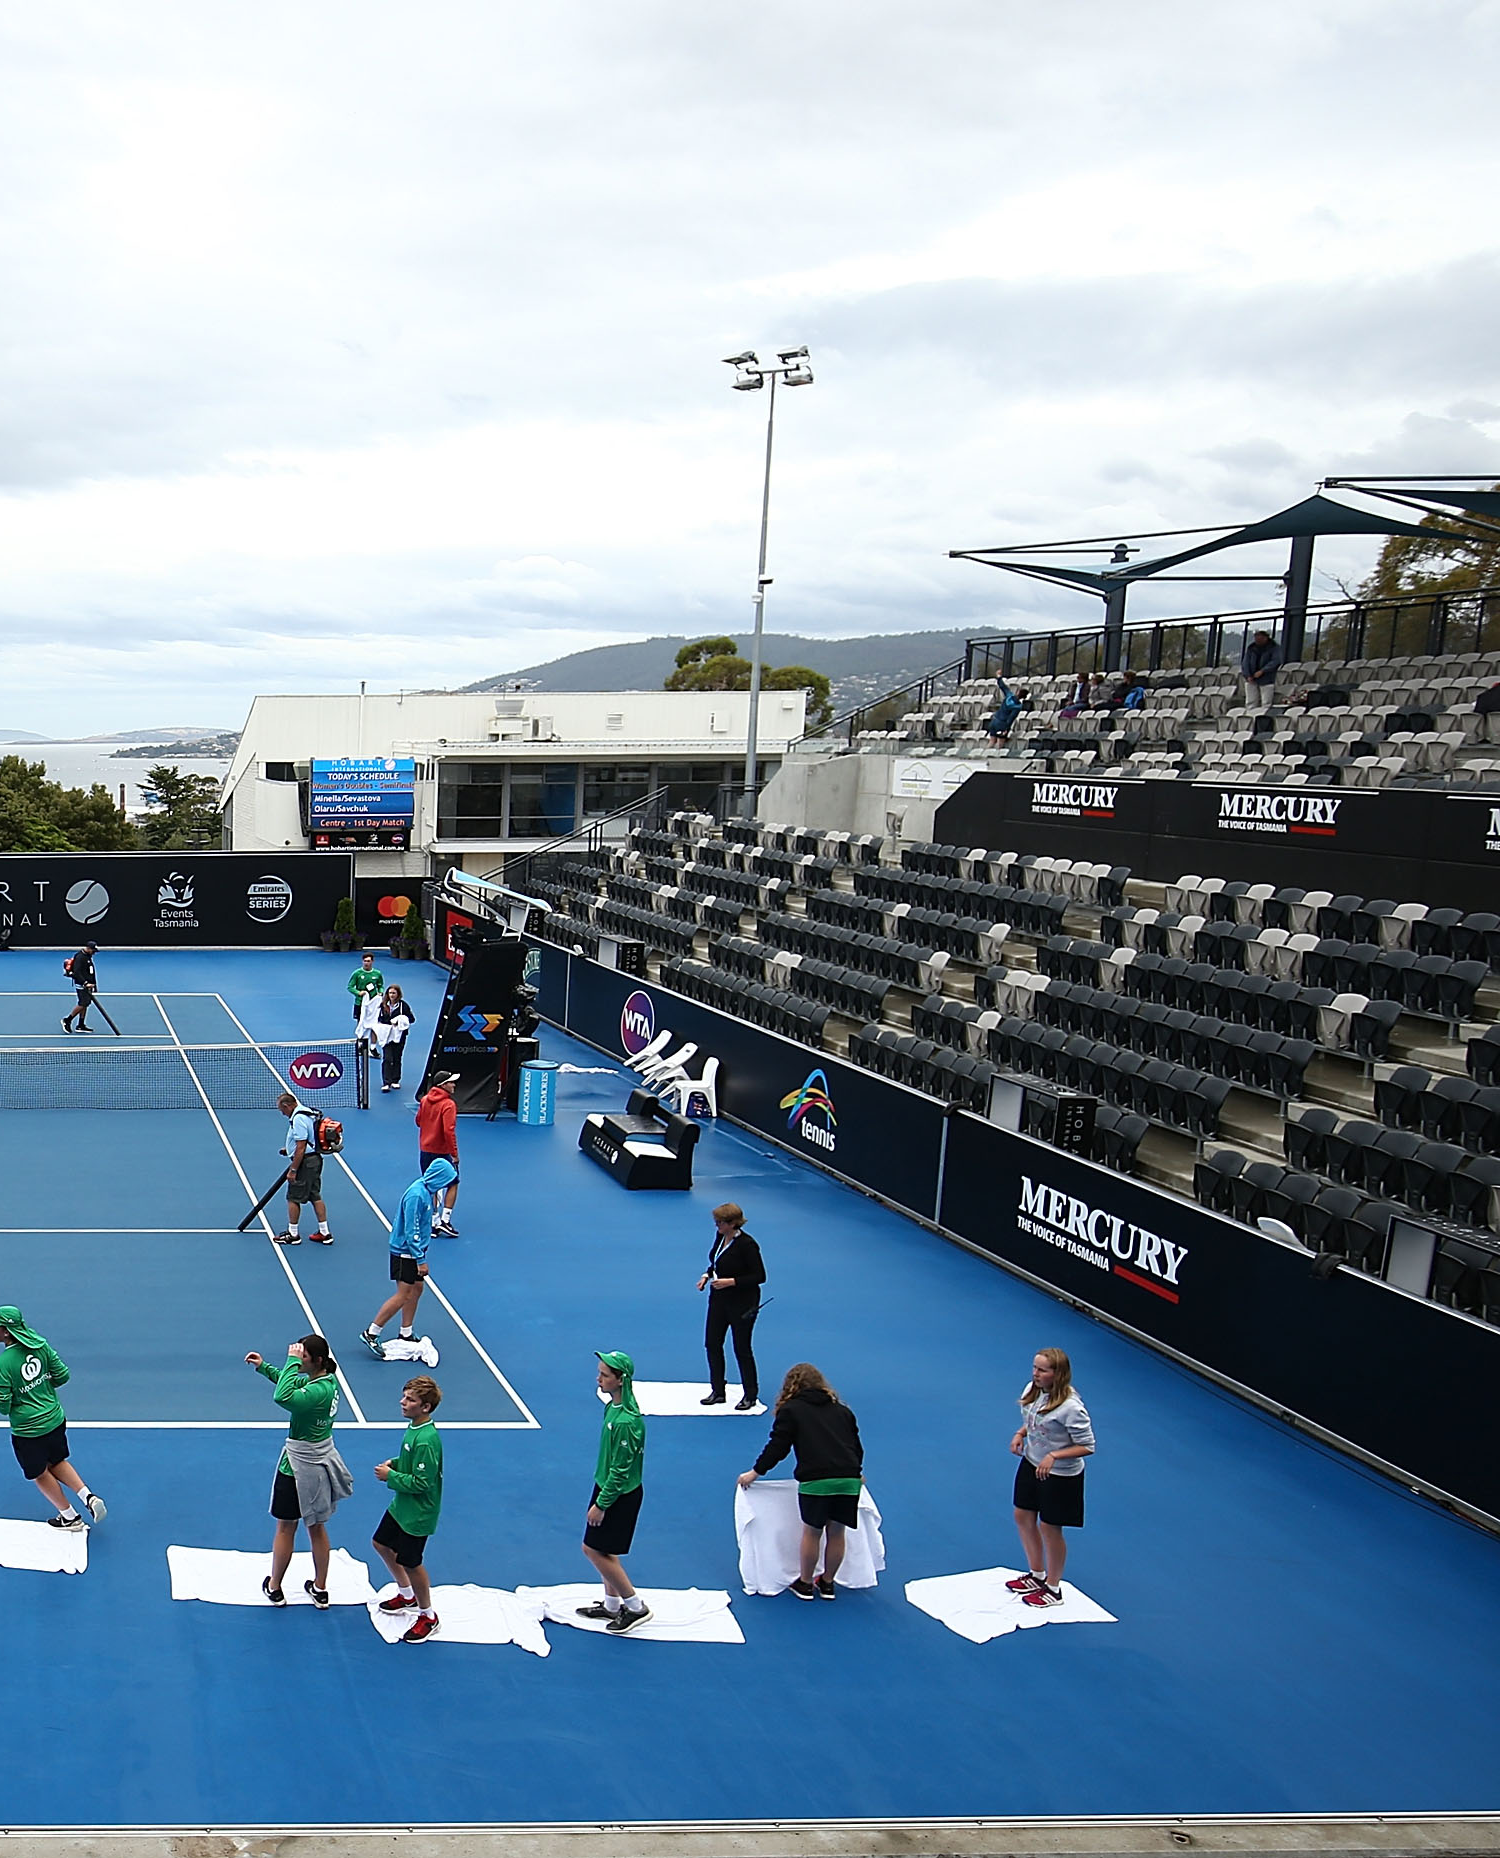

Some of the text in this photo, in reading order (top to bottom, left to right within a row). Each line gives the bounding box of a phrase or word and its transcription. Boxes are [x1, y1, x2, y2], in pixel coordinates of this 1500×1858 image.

[1032, 783, 1118, 808] MERCURY
[1219, 794, 1341, 824] MERCURY
[367, 819, 380, 827] Day
[1218, 820, 1287, 833] THE VOICE OF TASMANIA
[161, 909, 194, 918] Events
[249, 900, 286, 909] SERIES
[153, 919, 199, 928] Tasmania
[624, 1008, 650, 1040] WTA
[292, 1062, 340, 1079] WTA
[522, 1071, 531, 1123] BLACKMORES
[540, 1072, 549, 1124] BLACKMORES
[802, 1116, 836, 1152] tennis
[1017, 1215, 1109, 1272] THE VOICE OF TASMANIA
[1018, 1175, 1188, 1285] MERCURY
